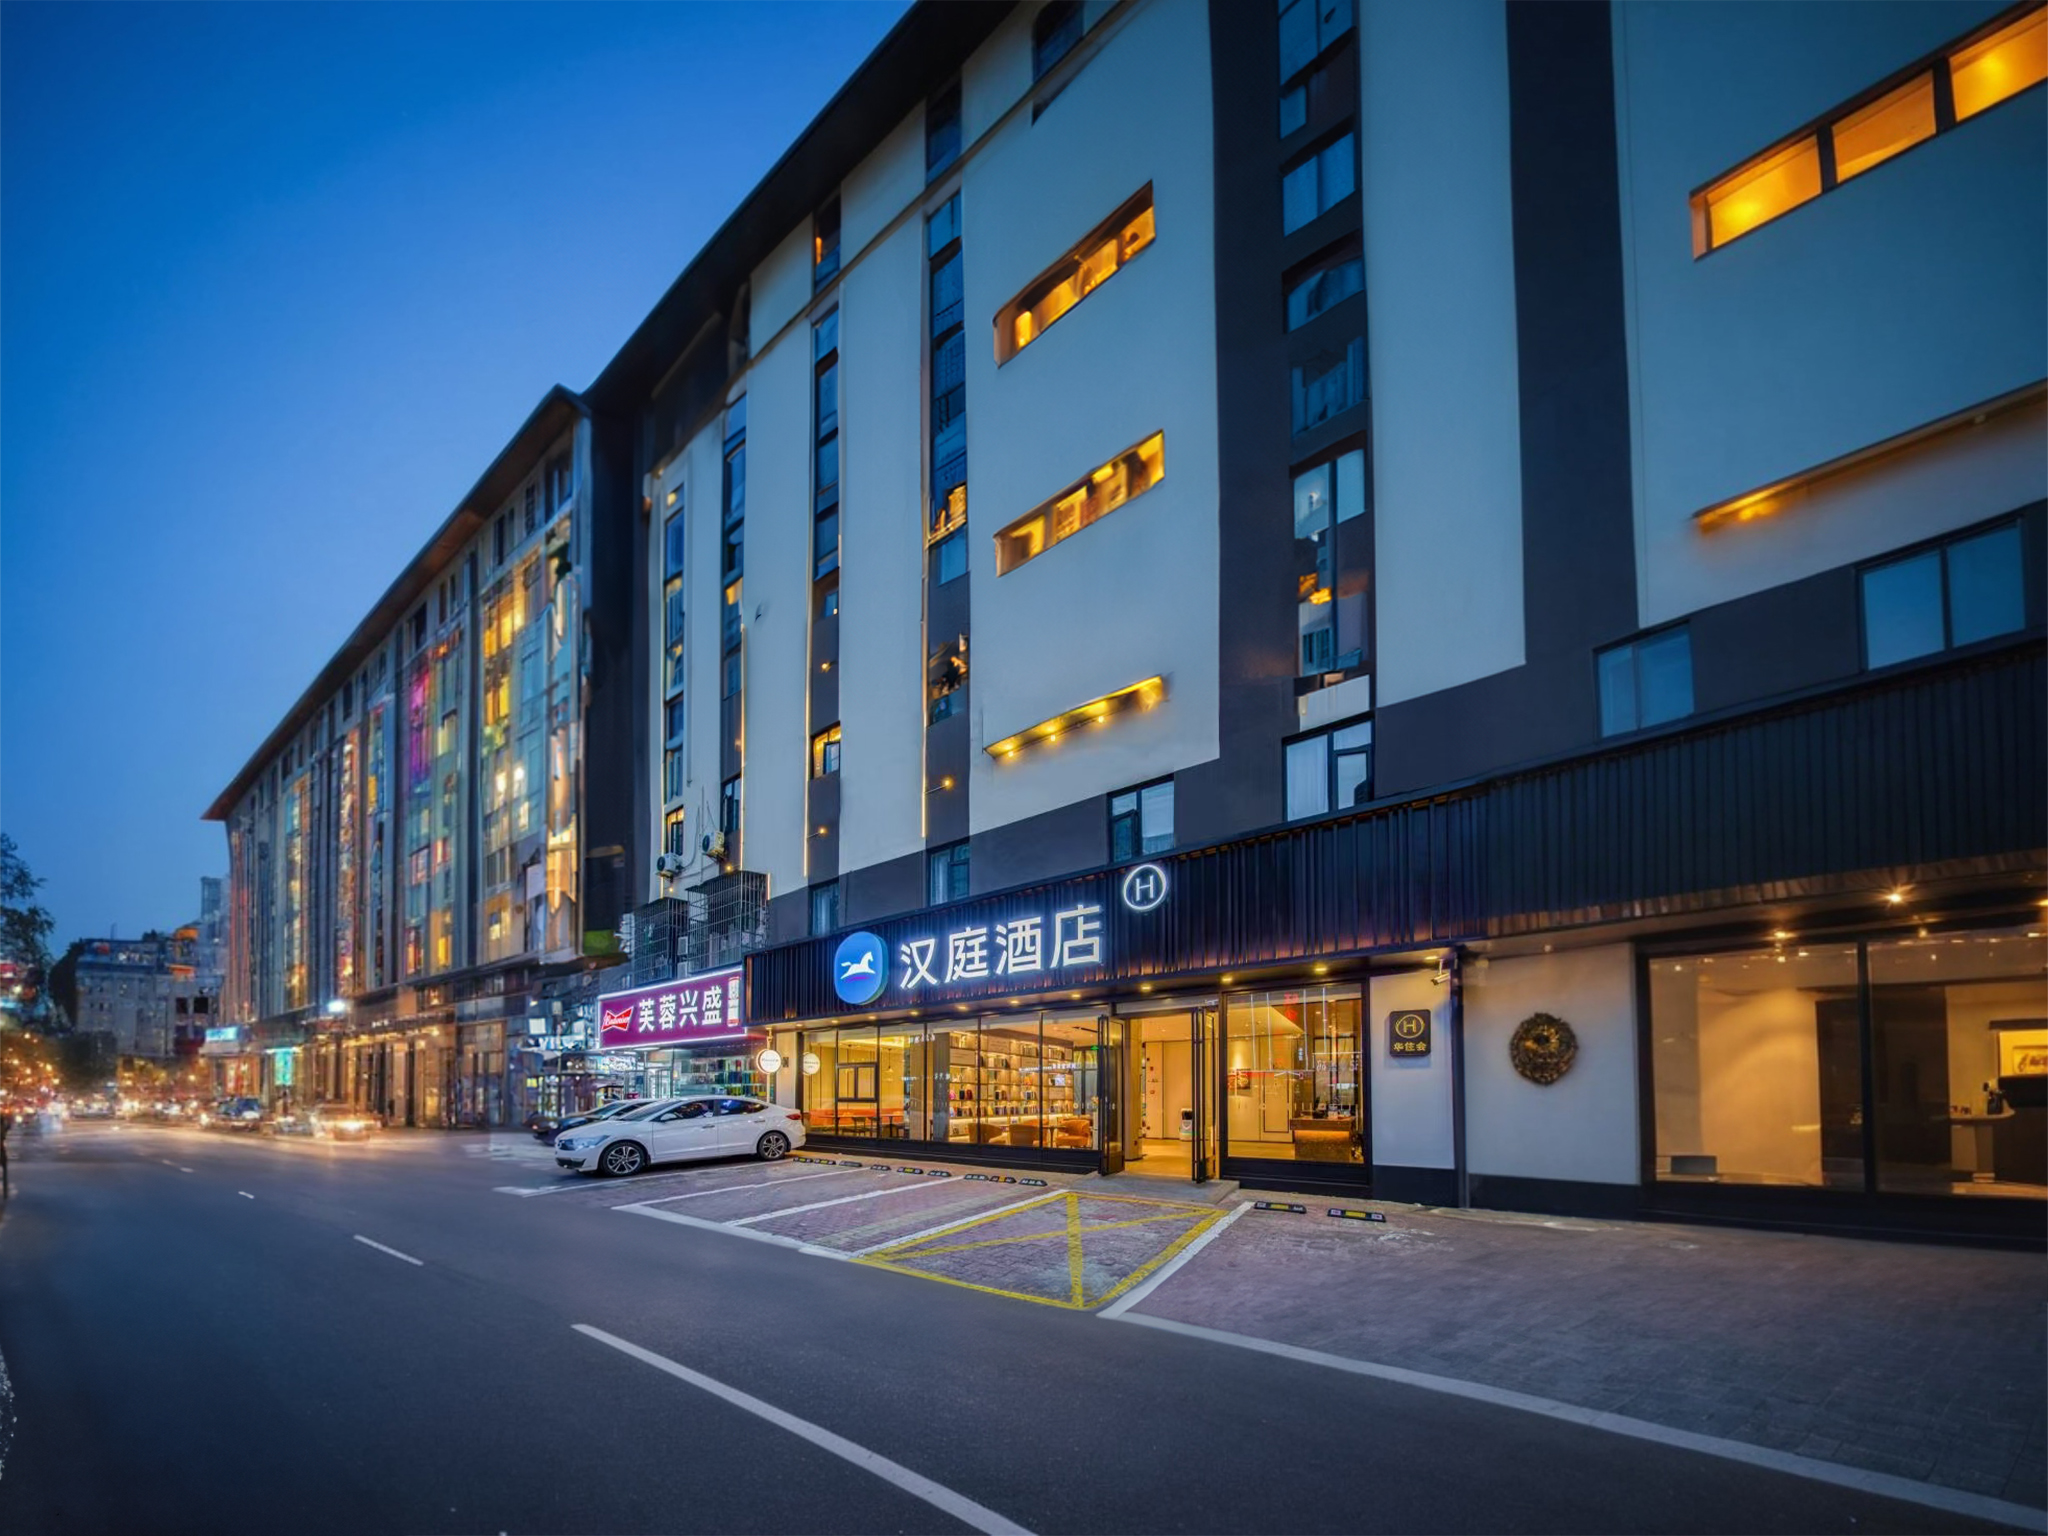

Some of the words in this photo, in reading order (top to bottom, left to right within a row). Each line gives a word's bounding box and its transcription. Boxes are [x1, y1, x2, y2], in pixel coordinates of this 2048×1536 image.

[1135, 874, 1155, 902] H
[900, 904, 1101, 989] 汉庭酒店
[639, 985, 722, 1033] 芙蓉兴盛
[1403, 1018, 1417, 1034] H
[1393, 1041, 1427, 1052] 华住会
